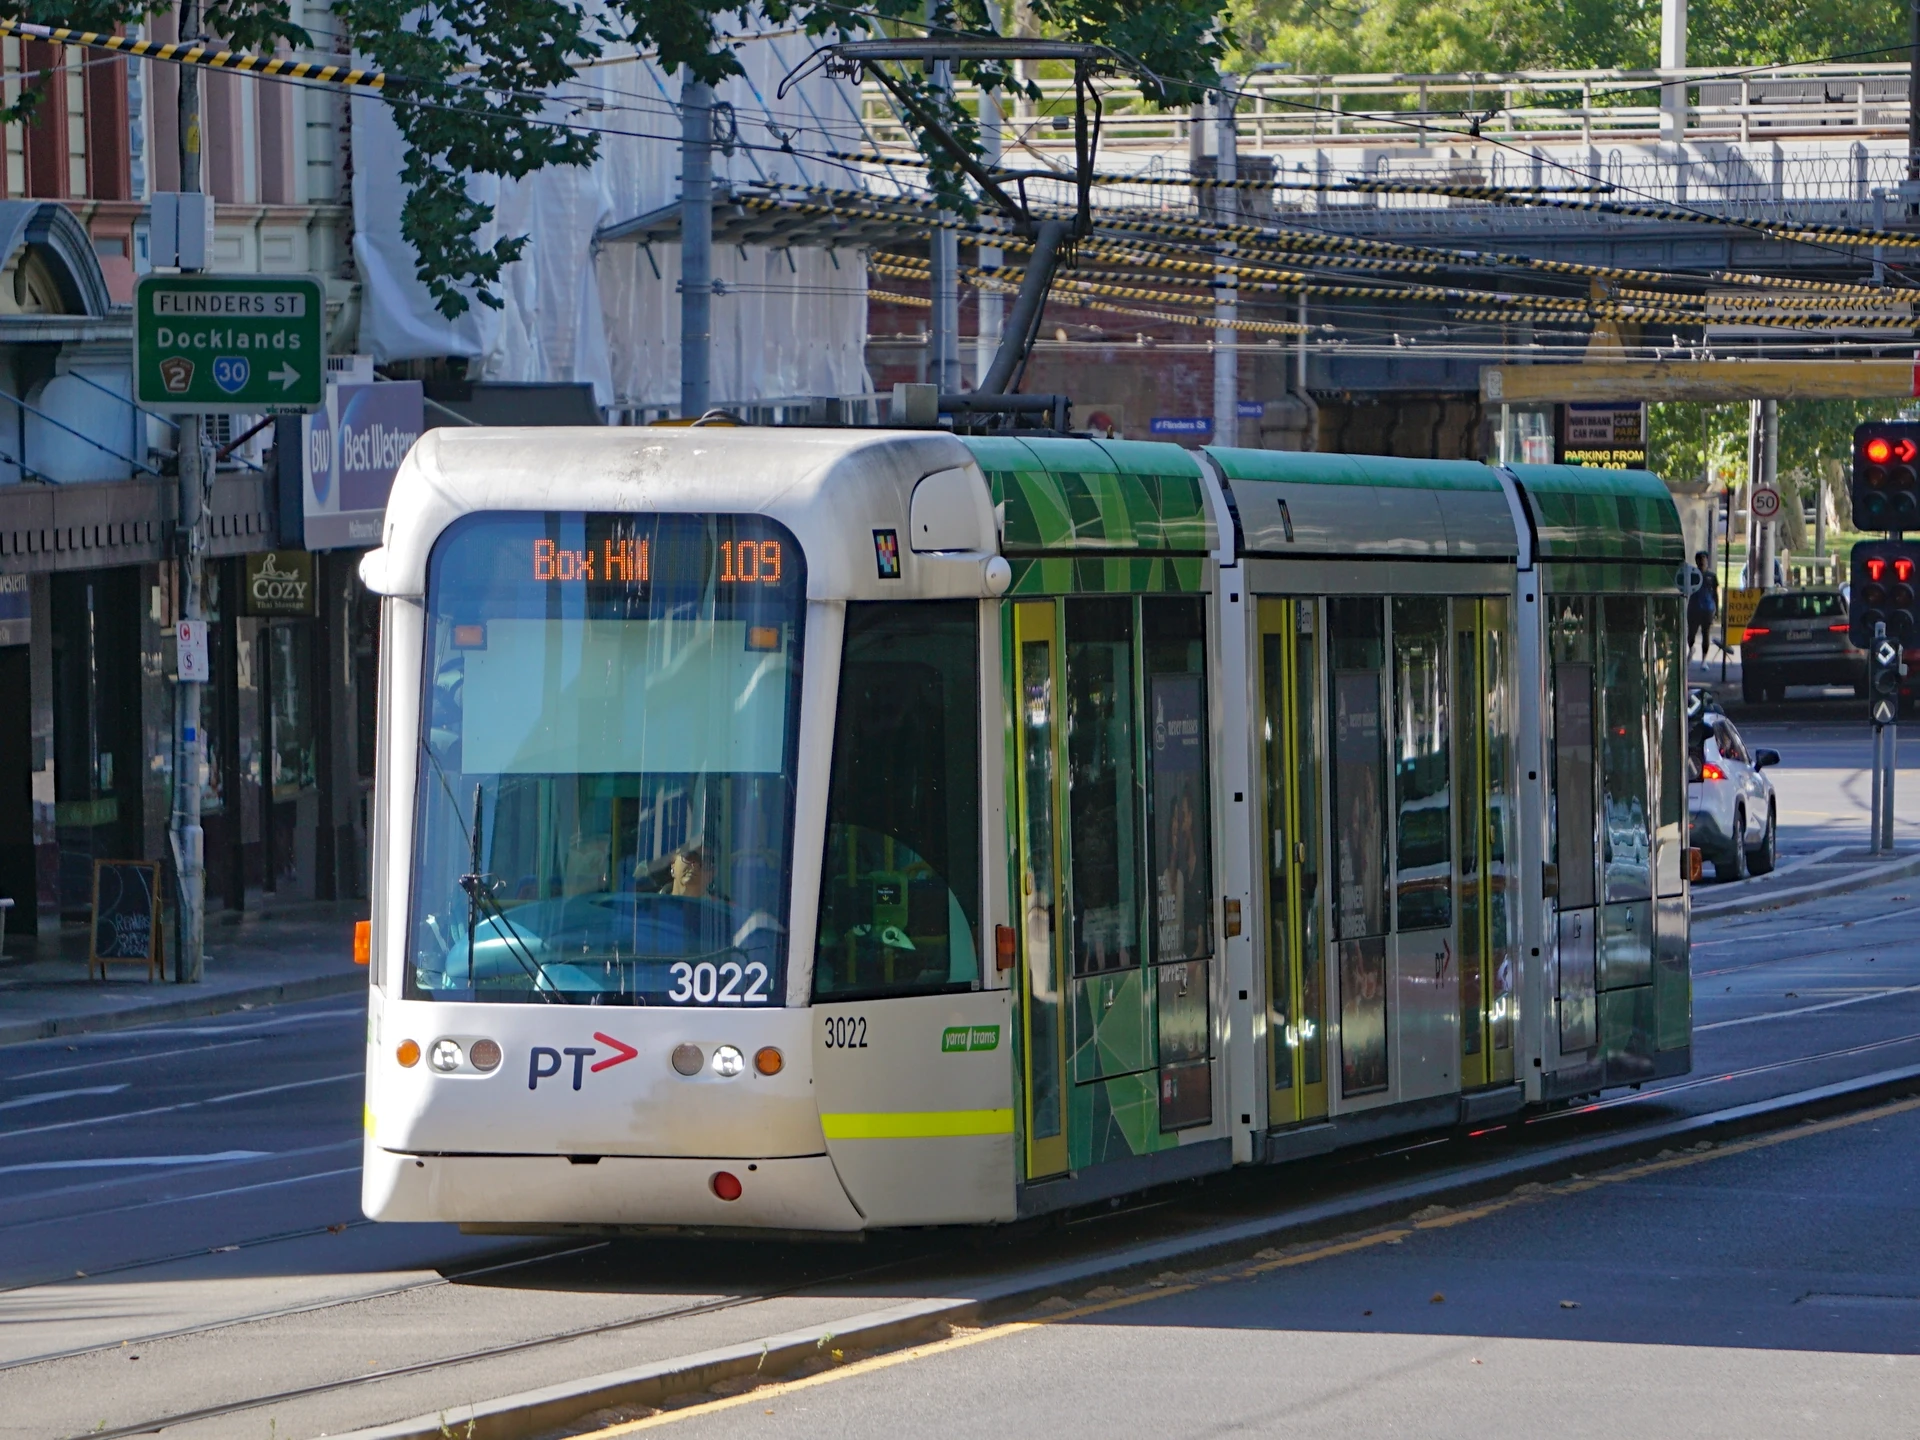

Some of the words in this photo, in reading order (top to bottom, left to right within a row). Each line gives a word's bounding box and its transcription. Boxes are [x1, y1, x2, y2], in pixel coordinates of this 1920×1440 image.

[160, 295, 265, 312] FLINDERS
[274, 296, 298, 313] ST
[157, 327, 301, 349] Docklands
[169, 367, 186, 388] 2
[219, 362, 245, 382] 30
[1162, 420, 1195, 429] Flinders
[1197, 420, 1206, 429] St
[311, 429, 331, 473] BW
[344, 424, 370, 472] Best
[1564, 450, 1611, 461] PARKING
[1613, 450, 1644, 461] FROM
[1756, 496, 1775, 509] 50
[534, 539, 594, 580] Box
[605, 539, 649, 580] Hill
[720, 540, 781, 581] 109
[253, 579, 307, 599] COZY
[1733, 590, 1753, 599] END
[1159, 895, 1176, 921] DATE
[1160, 924, 1179, 951] NIGHT
[669, 961, 768, 1003] 3022
[825, 1016, 868, 1048] 3022
[945, 1033, 966, 1048] yarra
[972, 1030, 996, 1045] trams
